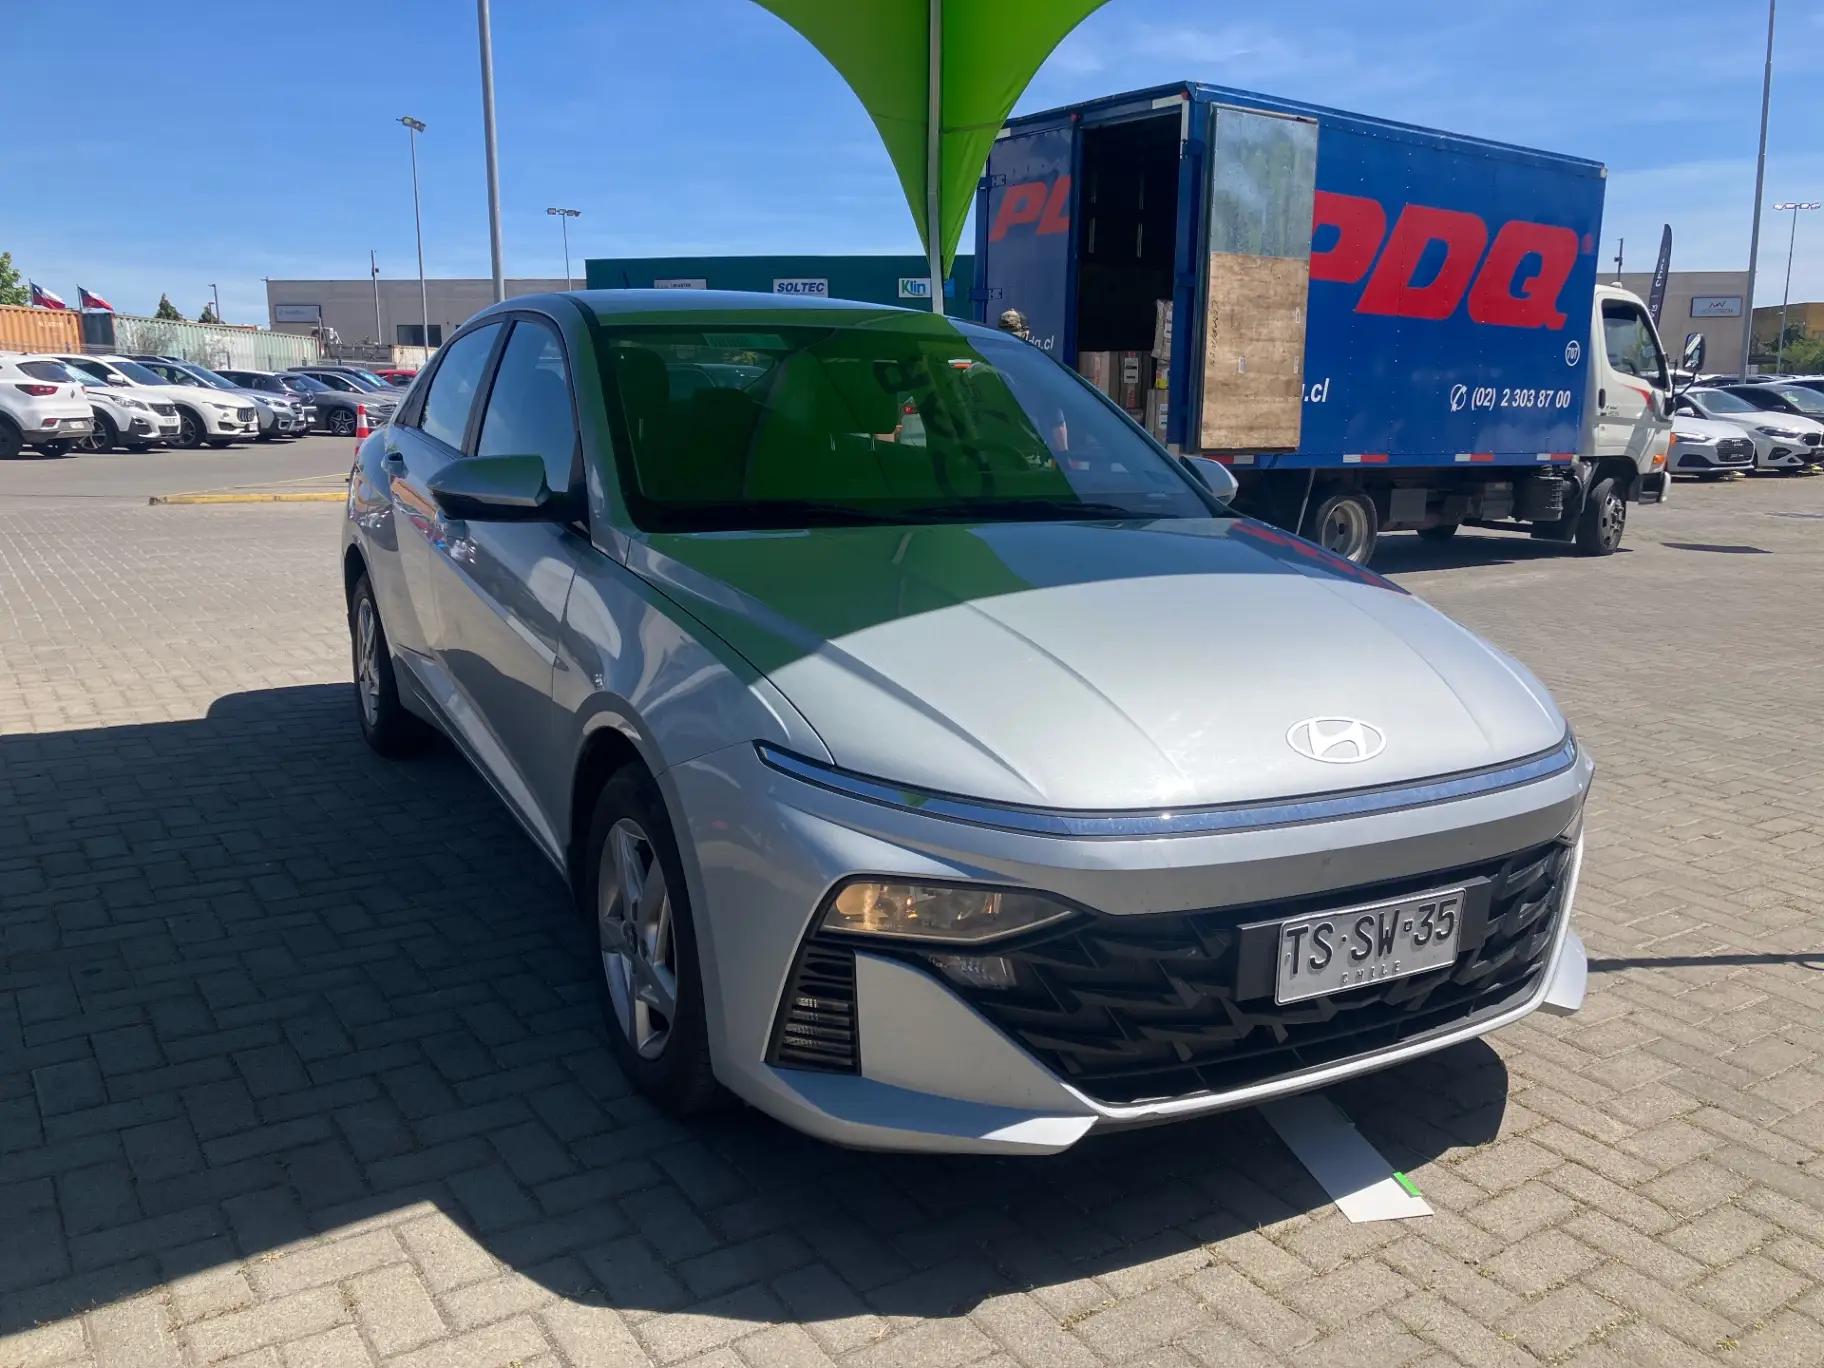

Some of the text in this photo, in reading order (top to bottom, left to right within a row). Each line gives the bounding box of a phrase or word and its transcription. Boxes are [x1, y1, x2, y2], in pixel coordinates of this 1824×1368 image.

[777, 282, 825, 293] SOLTEC
[901, 279, 926, 296] Klin
[1471, 386, 1572, 410] (02) 2 303 87 00
